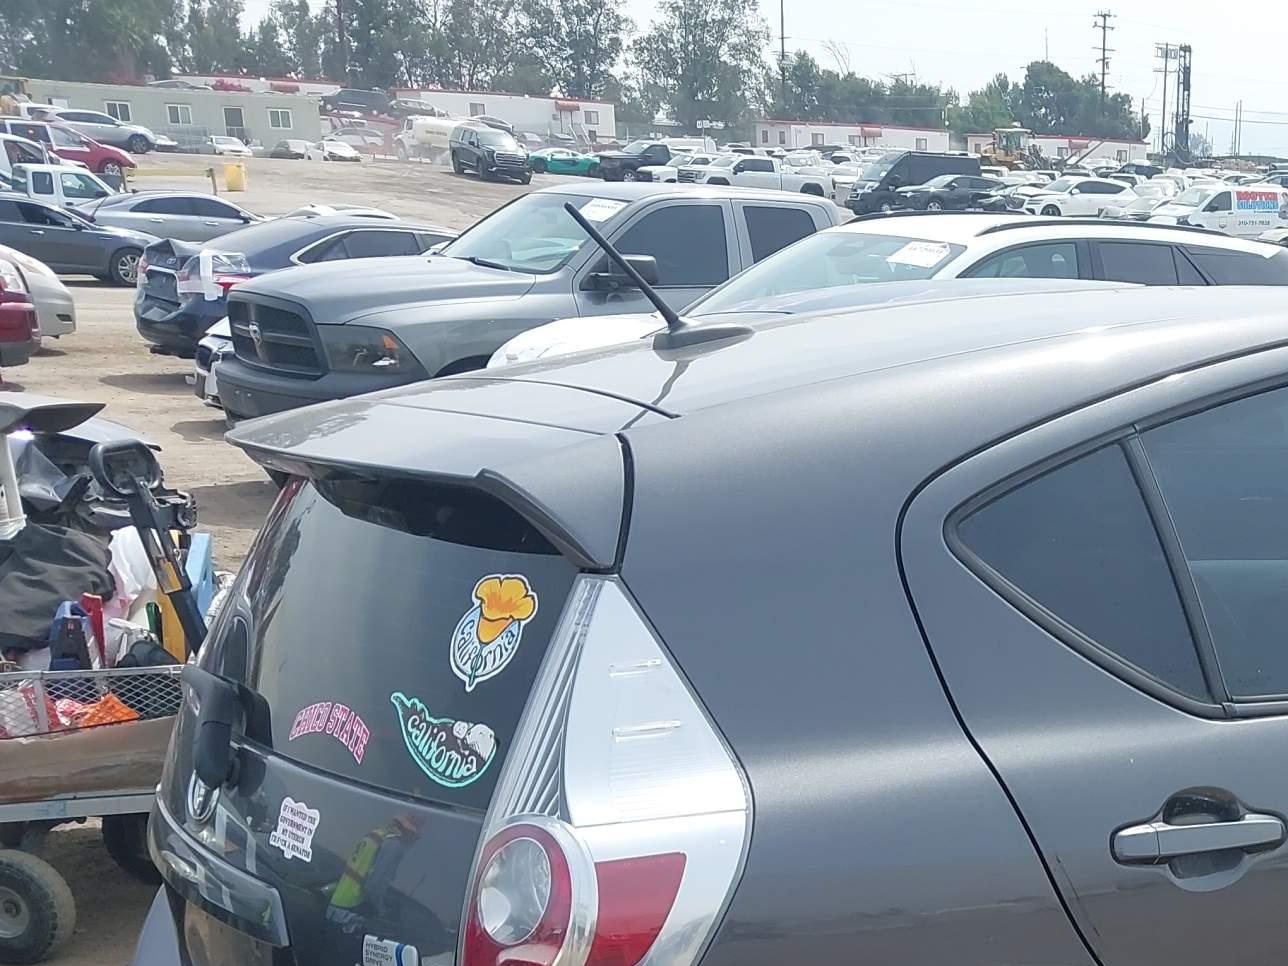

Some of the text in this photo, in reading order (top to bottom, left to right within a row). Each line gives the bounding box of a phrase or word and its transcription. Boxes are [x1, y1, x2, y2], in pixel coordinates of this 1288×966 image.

[1235, 191, 1279, 202] ROOTER
[1236, 201, 1279, 210] SOLUTIONS
[289, 702, 370, 764] CHICO STATE
[290, 806, 308, 821] WANTED
[280, 815, 308, 834] GOVERNMENT
[290, 844, 311, 859] SENATOR
[365, 942, 389, 953] HYBRID
[365, 949, 393, 961] SYNERGY
[365, 956, 384, 966] DRIVE
